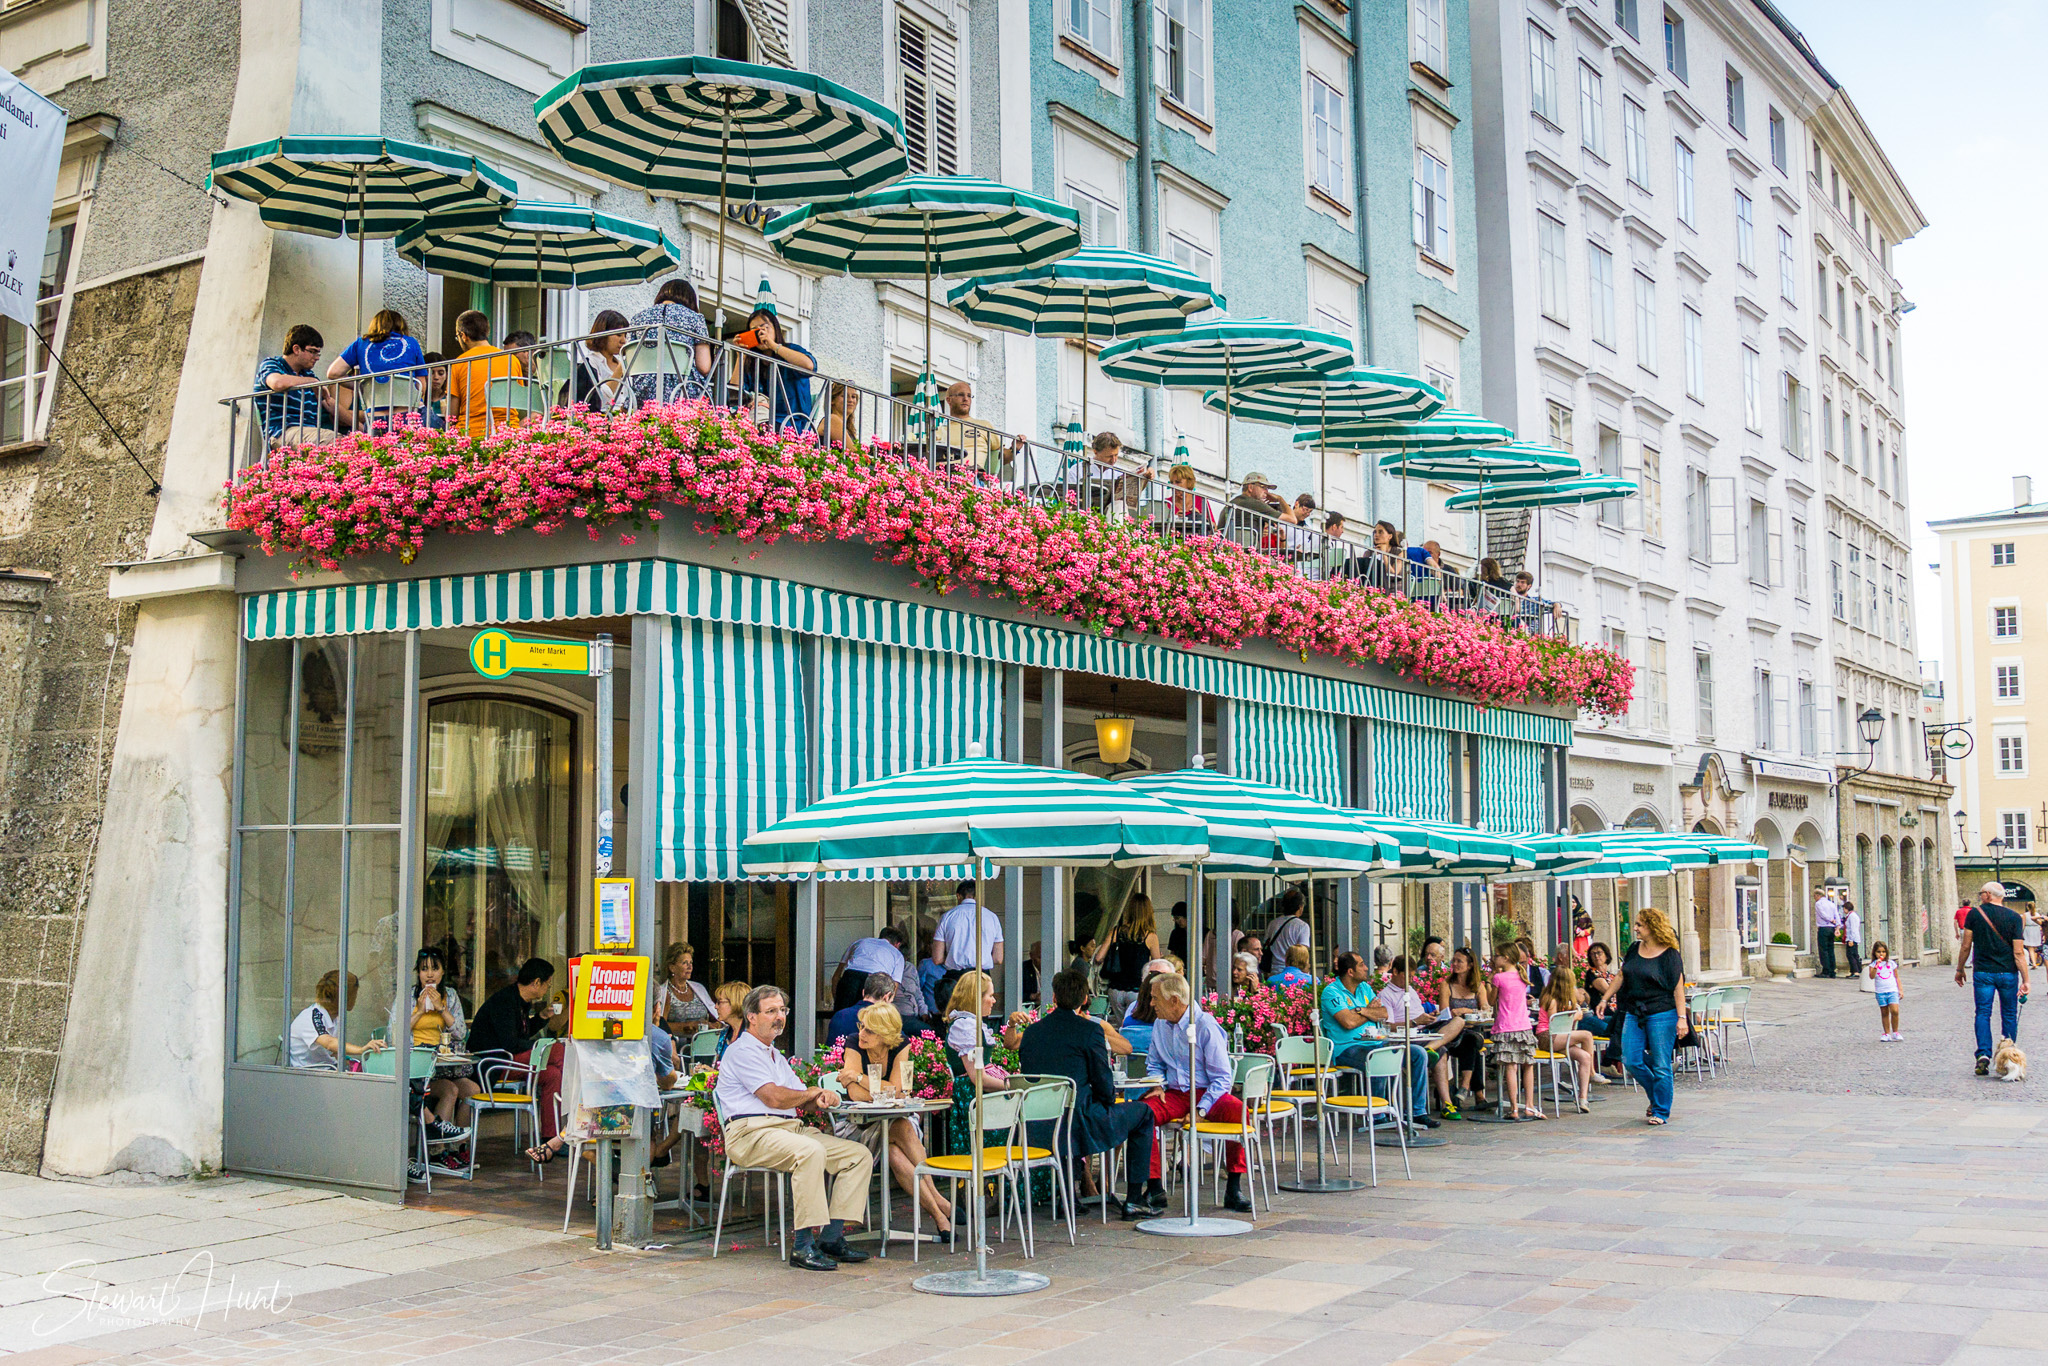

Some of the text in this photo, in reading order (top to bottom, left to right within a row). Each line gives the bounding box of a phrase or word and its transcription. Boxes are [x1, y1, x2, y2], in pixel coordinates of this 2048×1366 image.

[483, 638, 507, 669] H
[529, 646, 566, 655] Alter Markt
[590, 966, 636, 985] Kronen
[588, 985, 634, 1007] Zeitung
